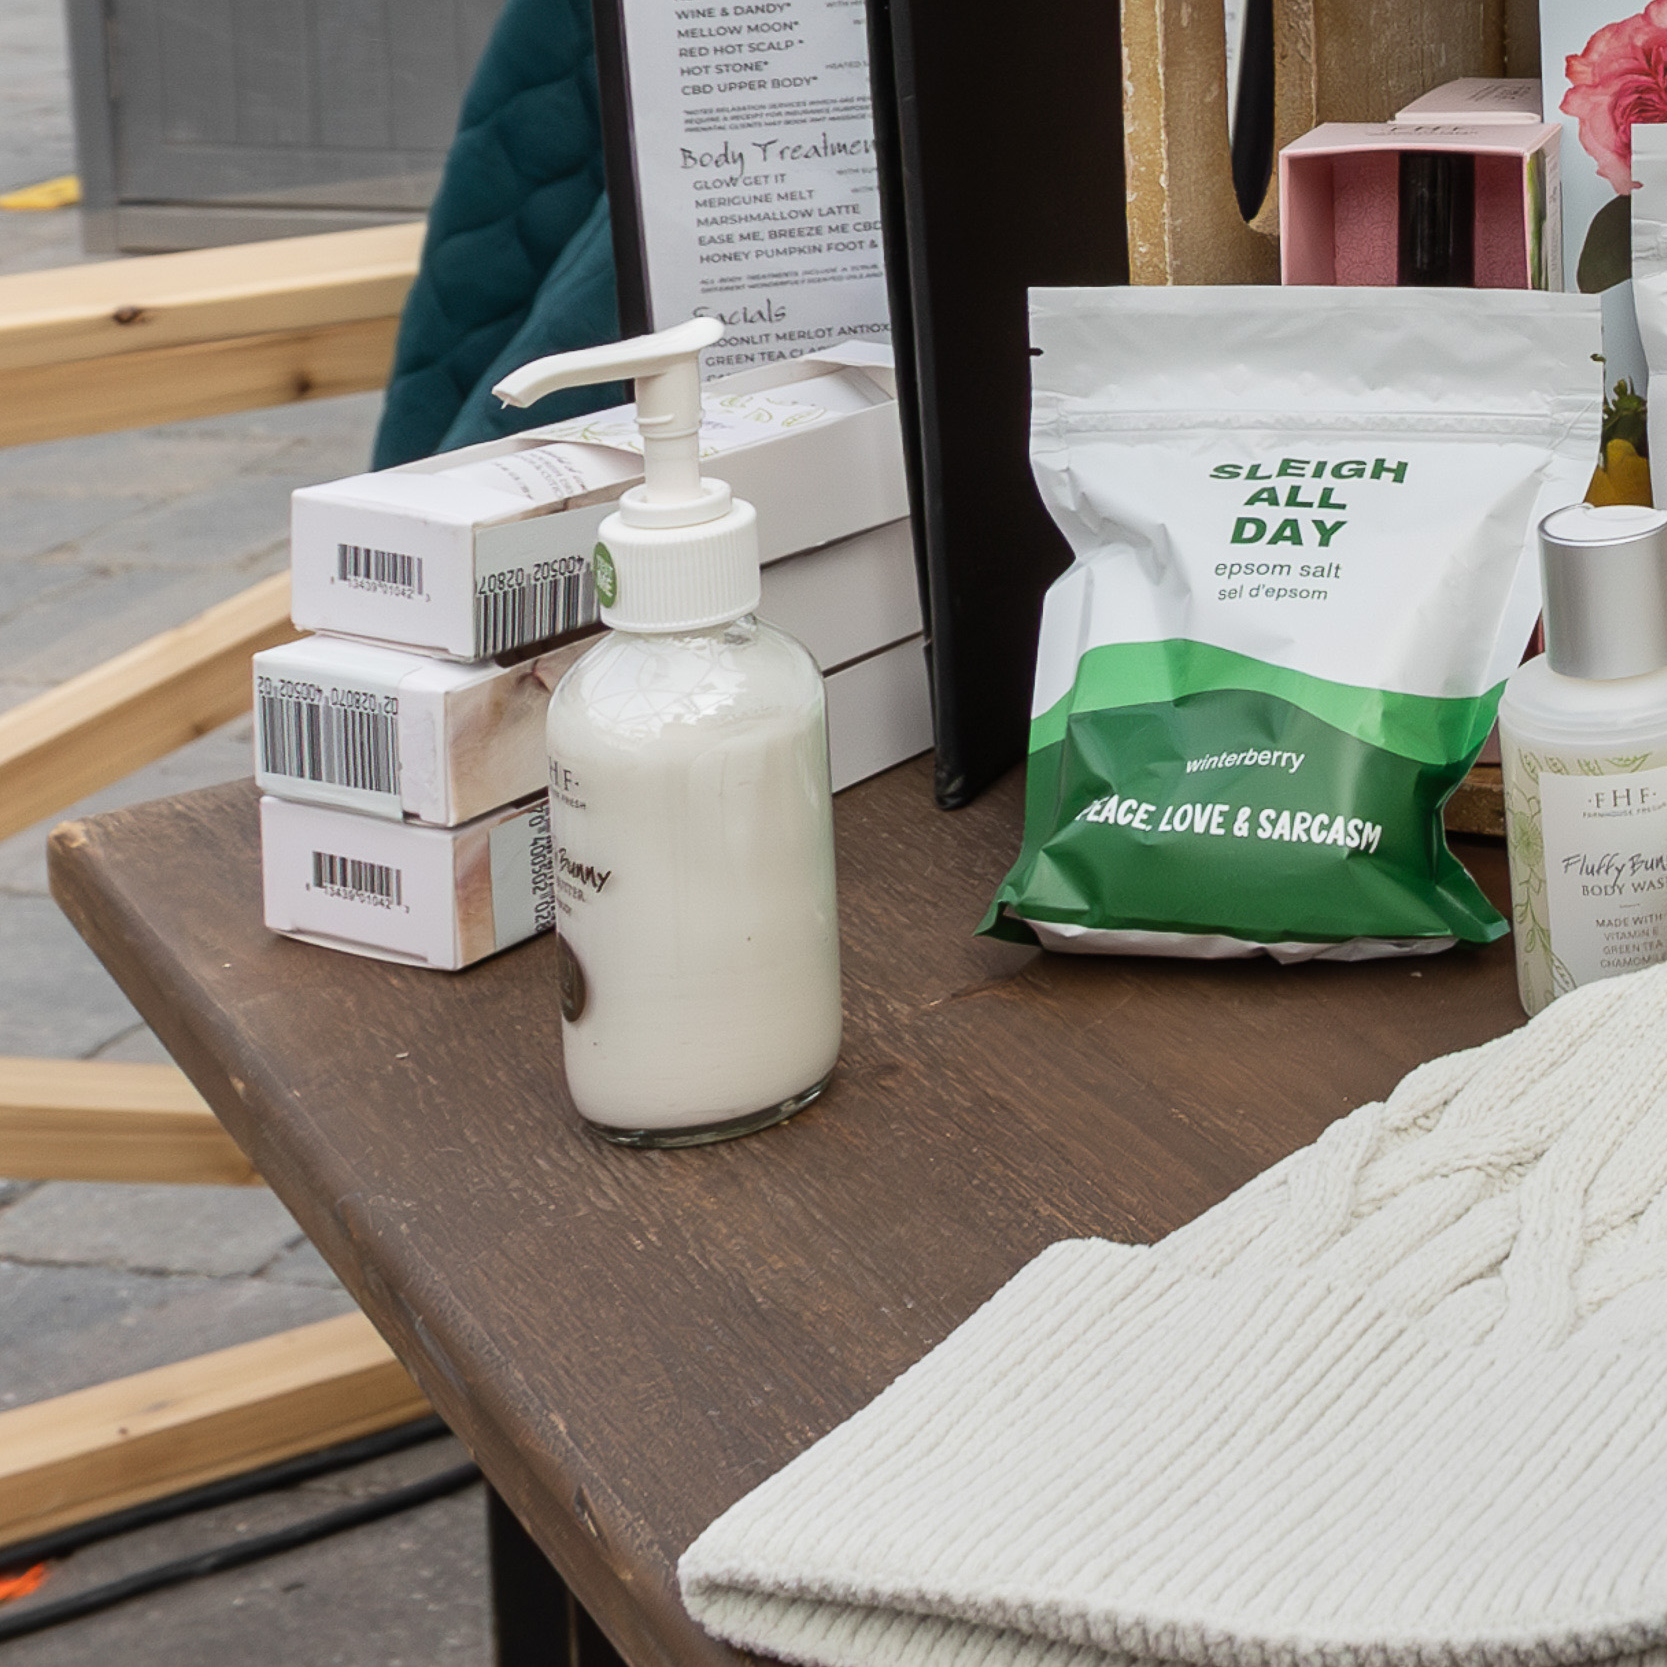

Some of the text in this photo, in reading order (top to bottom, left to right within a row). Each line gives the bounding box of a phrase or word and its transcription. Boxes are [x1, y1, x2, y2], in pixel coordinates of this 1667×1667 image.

[675, 7, 716, 20] WINE
[720, 6, 730, 17] &
[677, 25, 743, 39] MELLOW
[679, 39, 794, 58] RED HOT SCALP
[680, 65, 712, 77] HOT
[681, 84, 714, 96] CBD
[717, 79, 767, 93] UPPER
[680, 141, 744, 177] Body
[693, 173, 787, 191] GLOW GET IT
[777, 189, 815, 202] MELT
[697, 204, 861, 228] MARSHMALLOW LATTE
[698, 234, 734, 246] EASE
[768, 225, 823, 240] BREEZE
[828, 223, 849, 234] ME
[700, 239, 878, 264] HONEY PUMPKIN FOOT &
[776, 328, 833, 342] MERLOT
[705, 350, 787, 367] GREEN TEA
[1209, 458, 1408, 484] SLEIGH
[1243, 485, 1347, 510] ALL
[1230, 517, 1348, 547] DAY
[533, 554, 585, 584] 400502
[1214, 562, 1342, 579] epsom salt
[1217, 584, 1328, 601] sel d'epsom
[279, 678, 376, 713] 028070 400502
[1185, 748, 1306, 774] winterberry
[1594, 787, 1650, 809] FHF
[1075, 793, 1383, 854] PEACE, LOVE & SARCASM
[1562, 853, 1625, 884] Fluffy
[1582, 884, 1625, 896] BODY
[1595, 913, 1663, 928] MADE WITH
